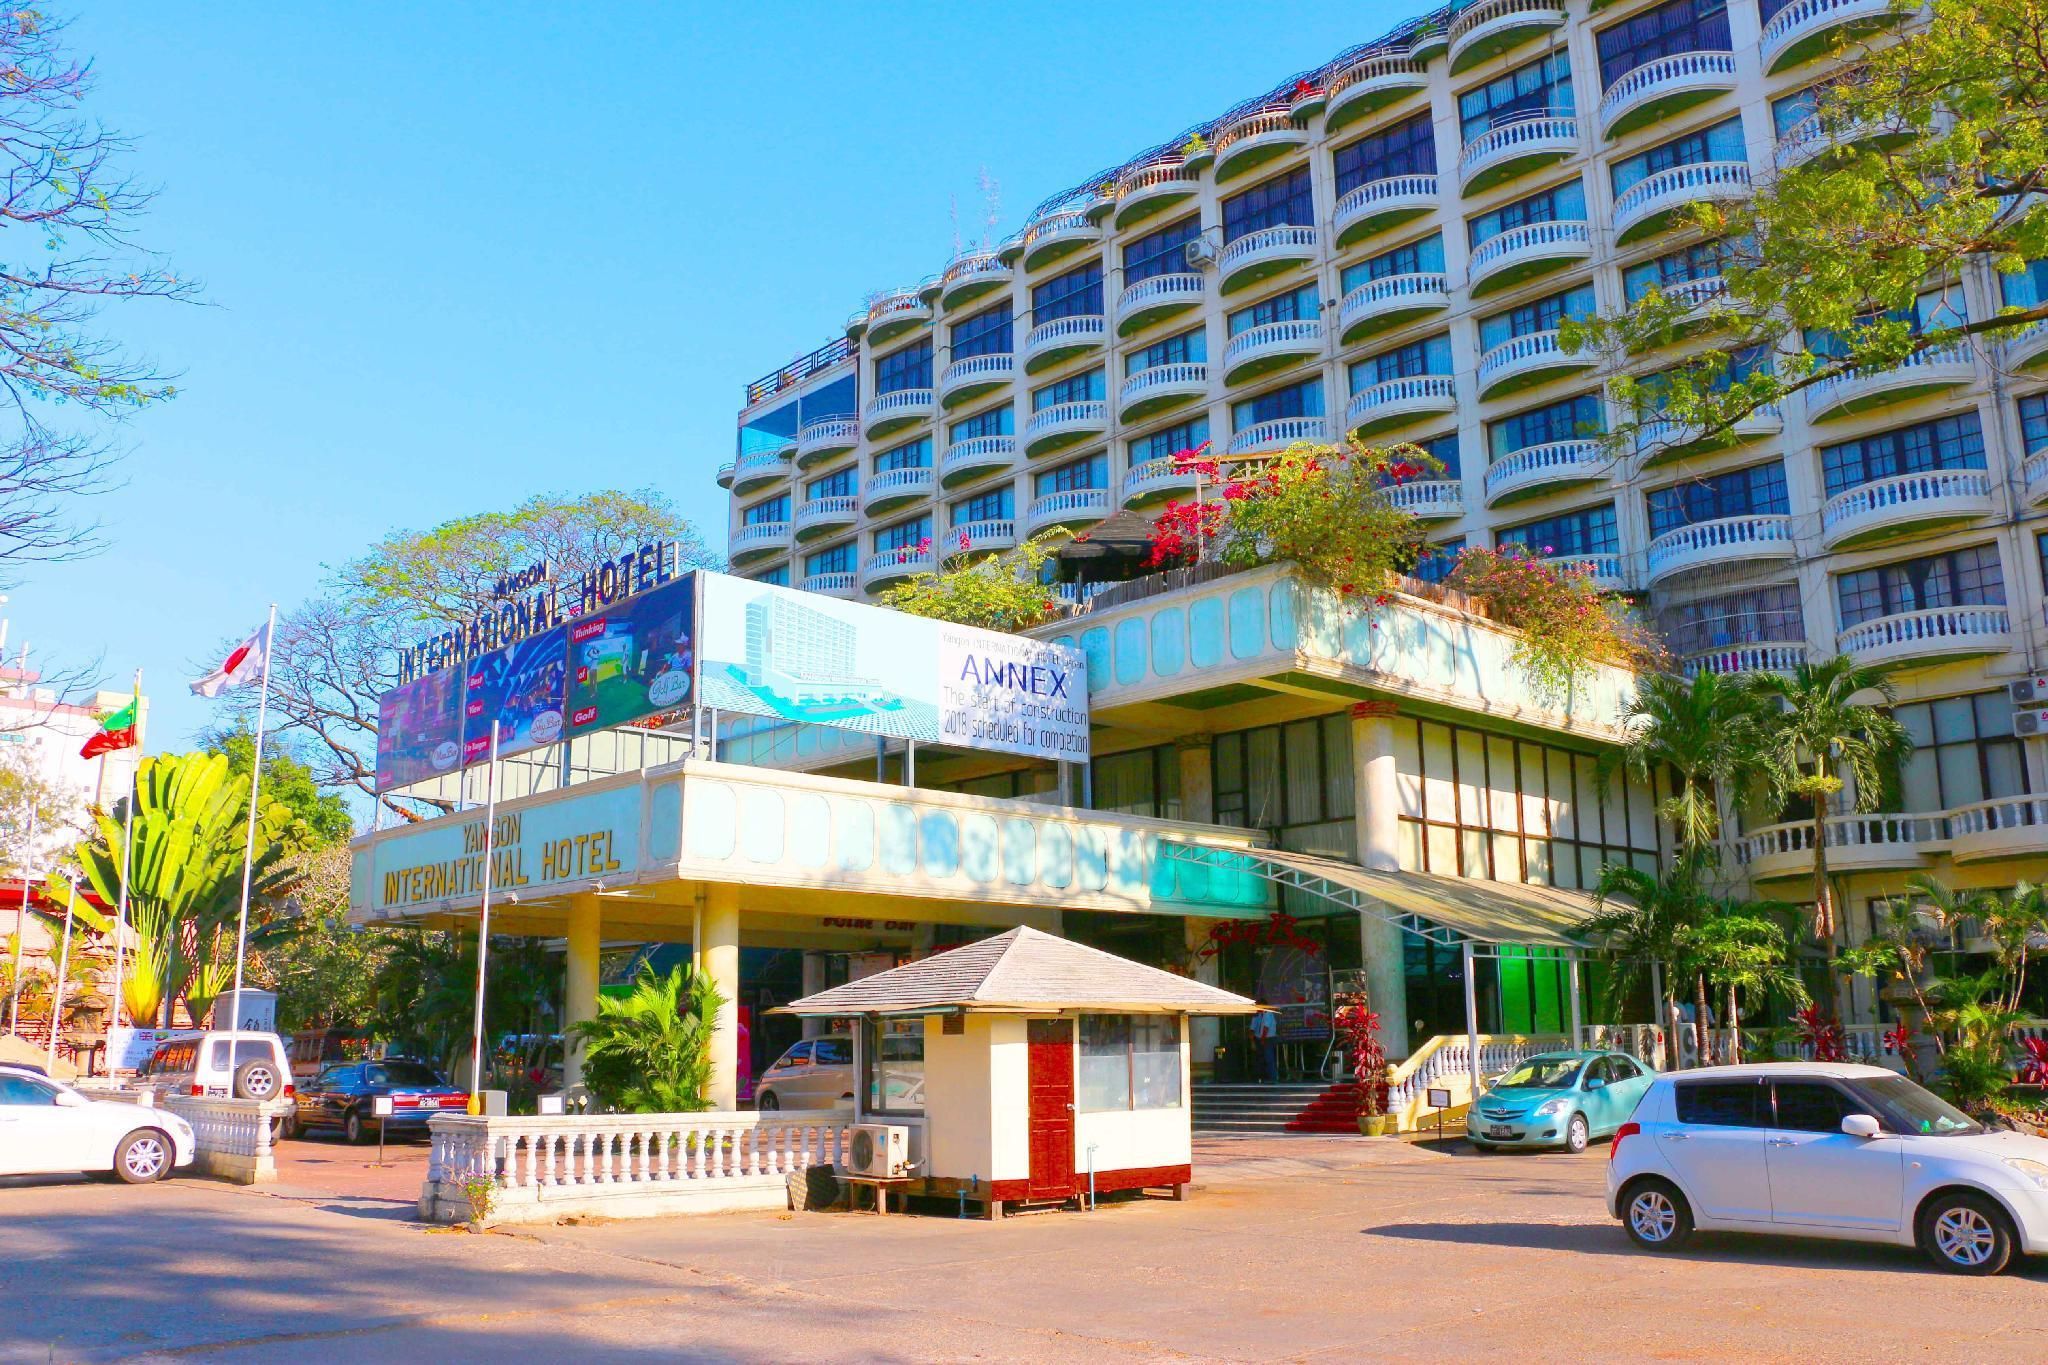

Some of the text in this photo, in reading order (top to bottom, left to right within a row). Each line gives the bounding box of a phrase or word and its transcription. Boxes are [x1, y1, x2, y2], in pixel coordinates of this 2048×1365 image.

[398, 541, 674, 686] INTERNATIONAL HOTEL
[575, 621, 605, 639] Thinking
[470, 676, 483, 686] Best
[578, 668, 586, 680] of
[961, 654, 1067, 699] ANNEX
[575, 707, 596, 722] Golf
[944, 686, 1087, 727] The start of construction
[944, 710, 1088, 755] 2018 scheduled for completion
[464, 813, 522, 854] YANGON
[384, 830, 621, 905] INTERNATIONAL HOTEL
